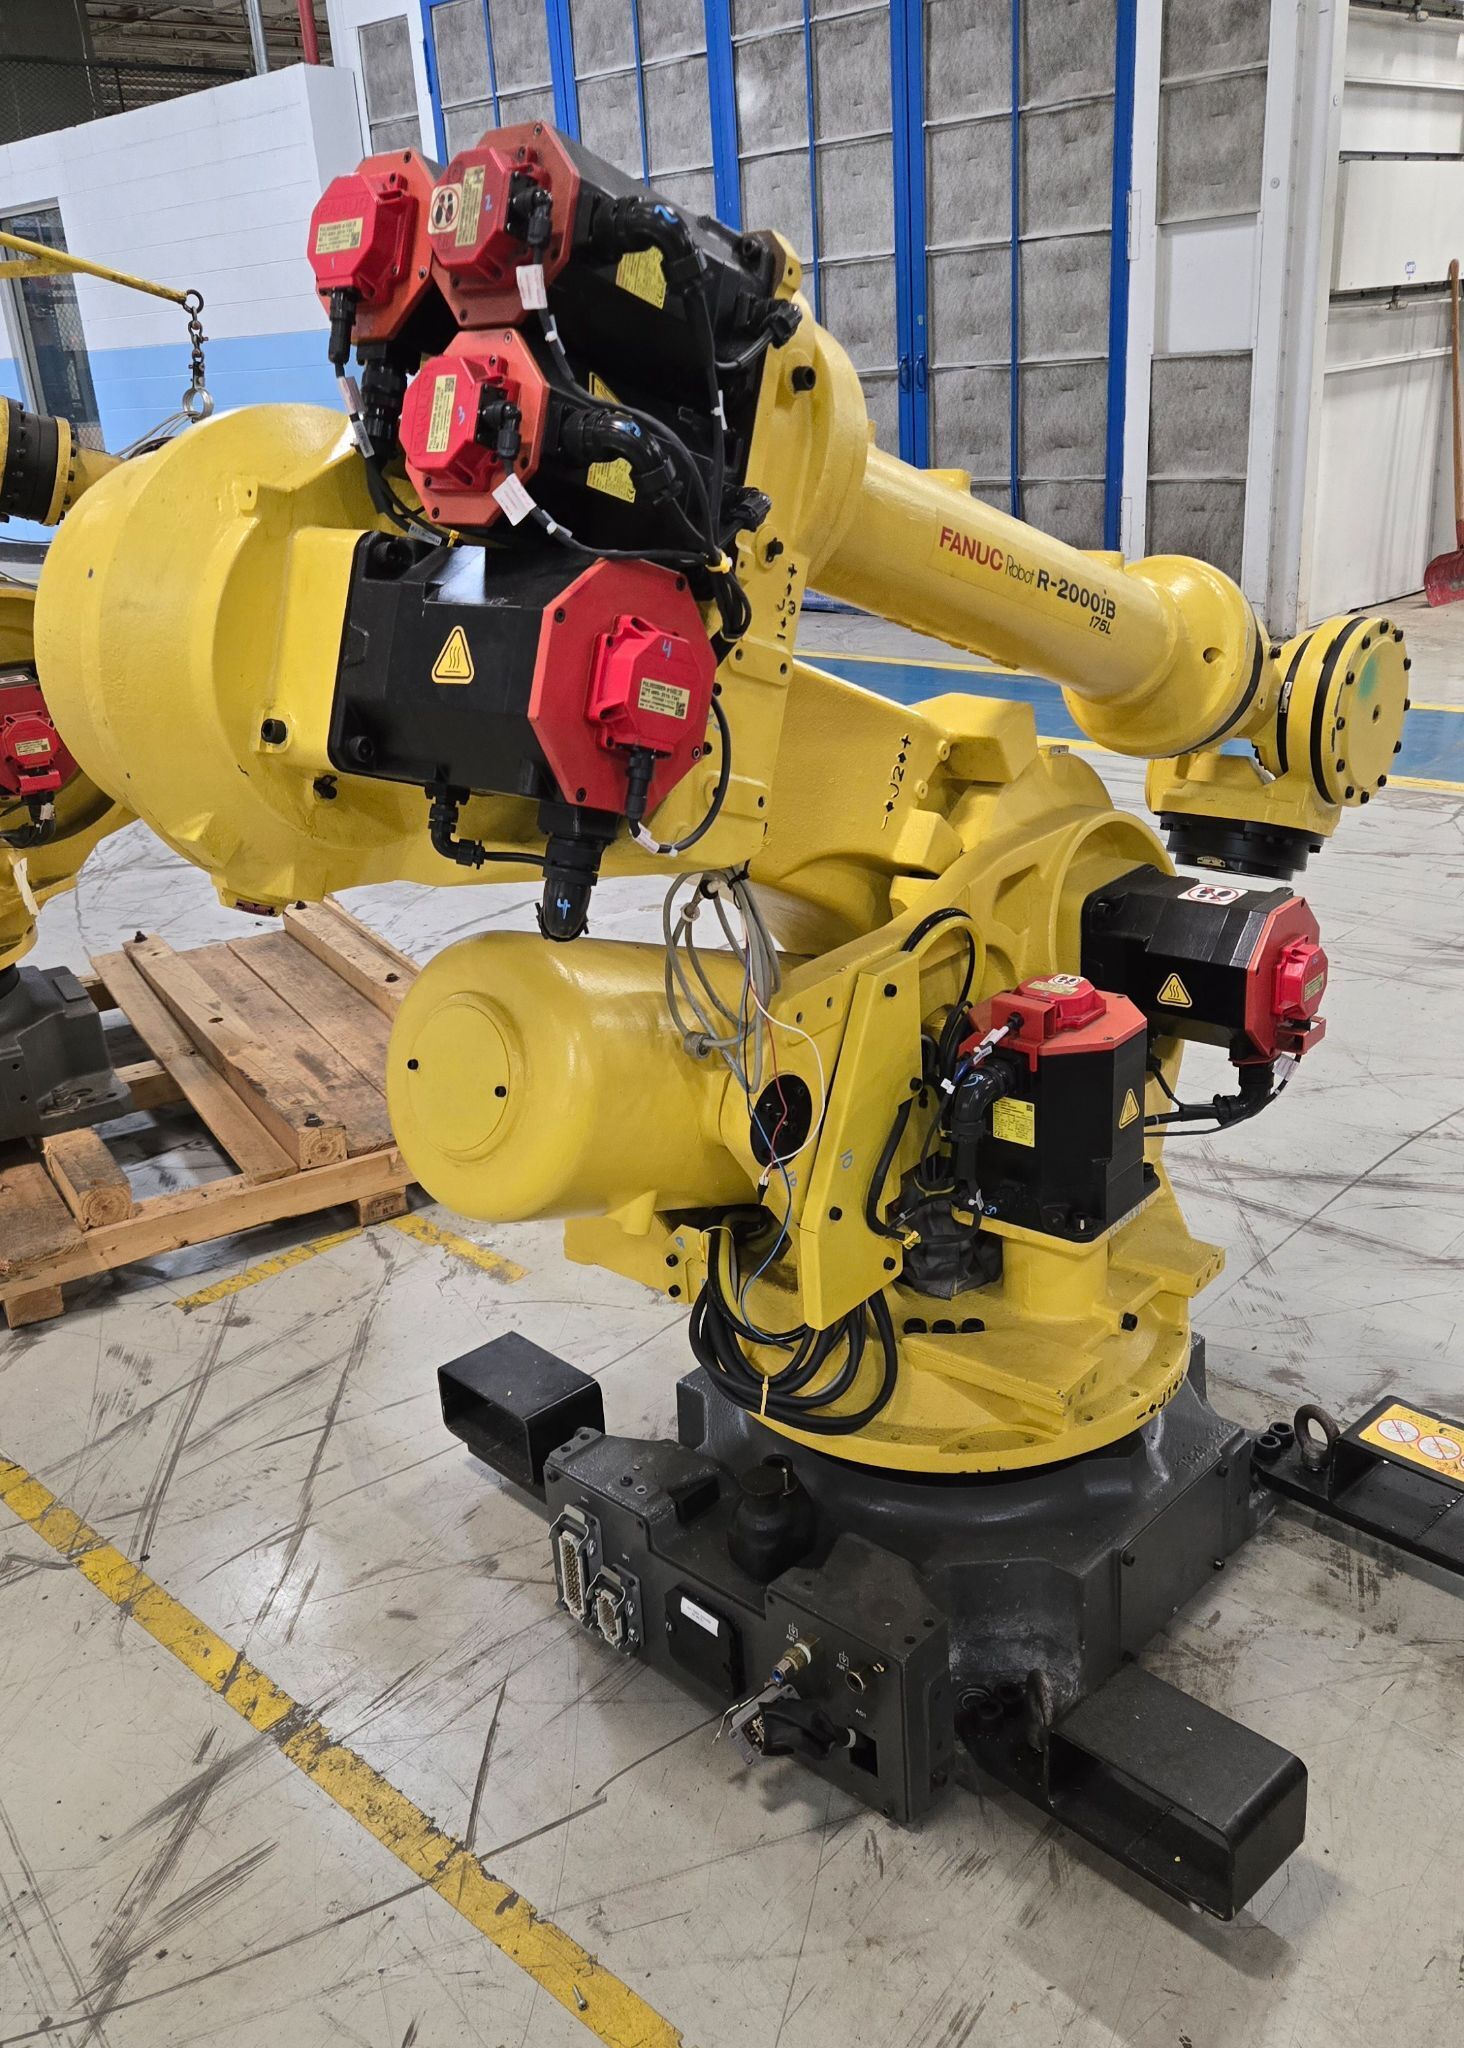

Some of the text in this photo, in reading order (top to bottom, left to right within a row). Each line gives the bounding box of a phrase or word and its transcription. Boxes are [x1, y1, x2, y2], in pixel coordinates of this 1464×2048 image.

[484, 193, 493, 212] 2
[457, 404, 467, 427] 3
[939, 526, 1116, 620] FANUC Robot R-2000iB
[776, 598, 796, 616] J3
[1088, 615, 1112, 635] 175L
[661, 638, 673, 660] 4
[888, 764, 905, 798] J2
[556, 897, 571, 920] 4
